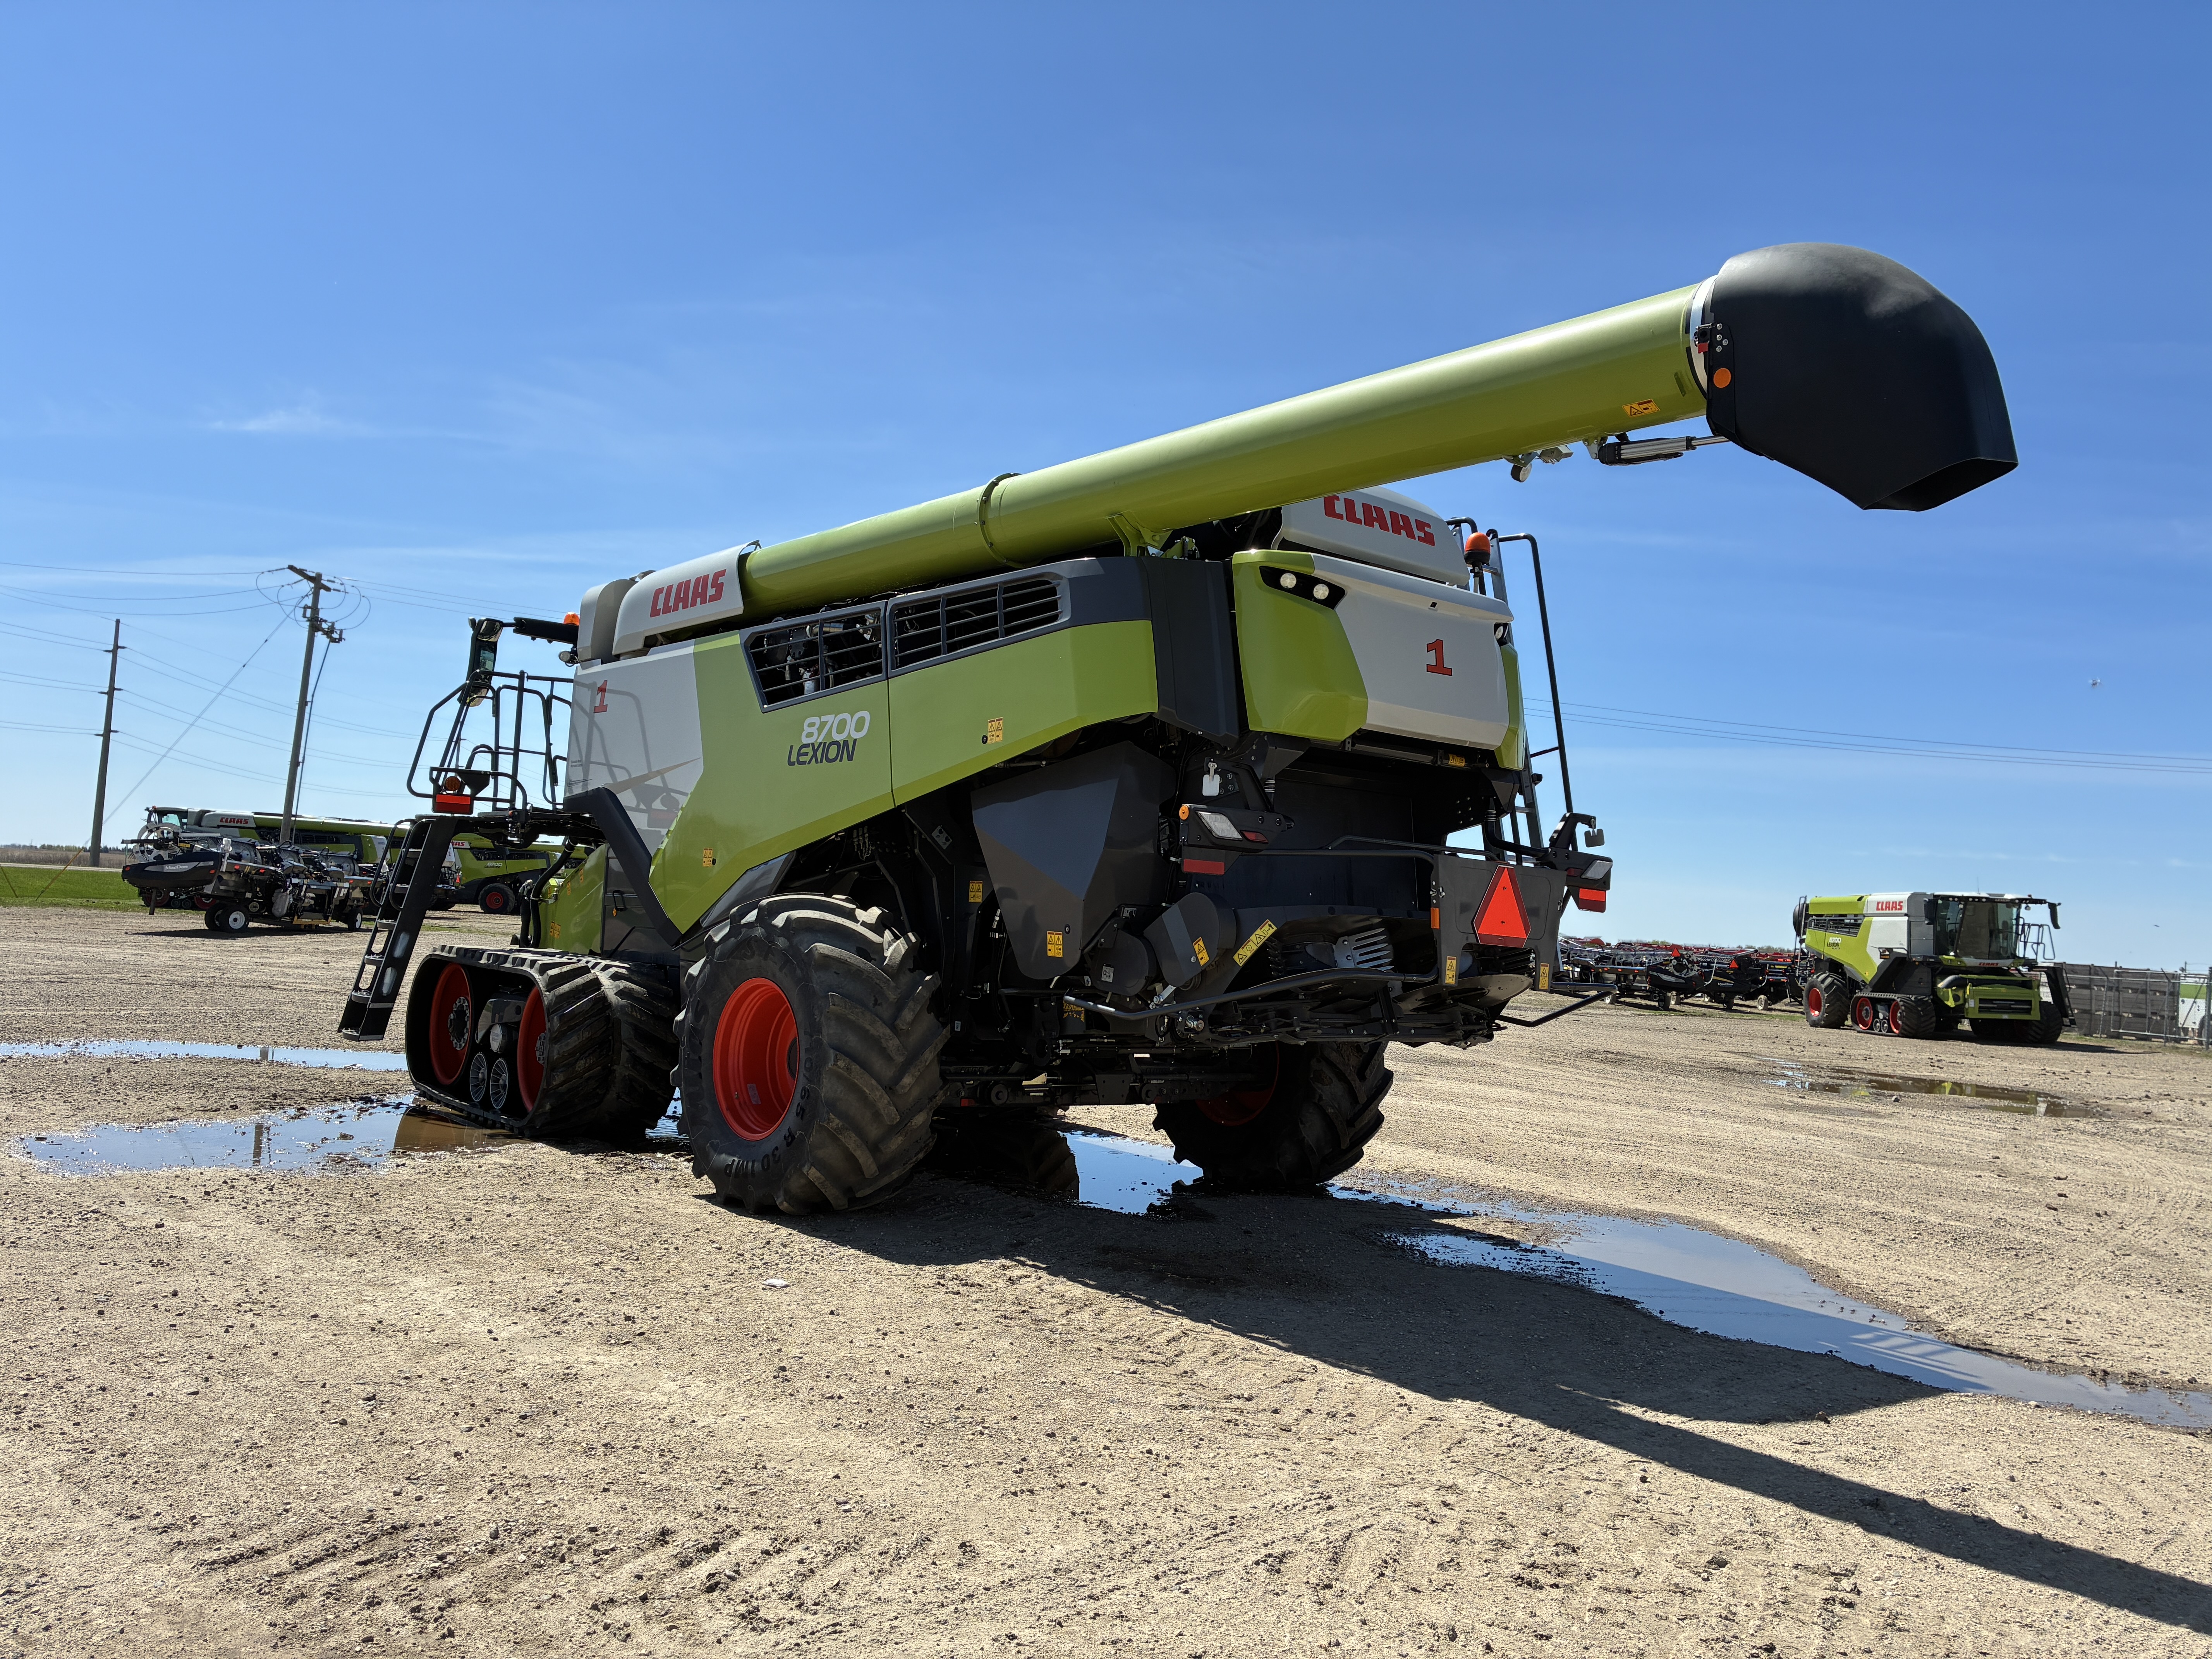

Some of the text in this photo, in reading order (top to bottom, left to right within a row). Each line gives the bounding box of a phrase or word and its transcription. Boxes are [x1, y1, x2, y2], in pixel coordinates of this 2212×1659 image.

[1324, 495, 1435, 546] CLAAS
[650, 569, 726, 618] CLAAS
[1426, 639, 1452, 676] 1
[593, 680, 608, 713] 1
[801, 711, 870, 744] 8700
[787, 739, 857, 766] LEXION
[1876, 901, 1903, 911] CLAAS
[761, 1146, 781, 1171] 30
